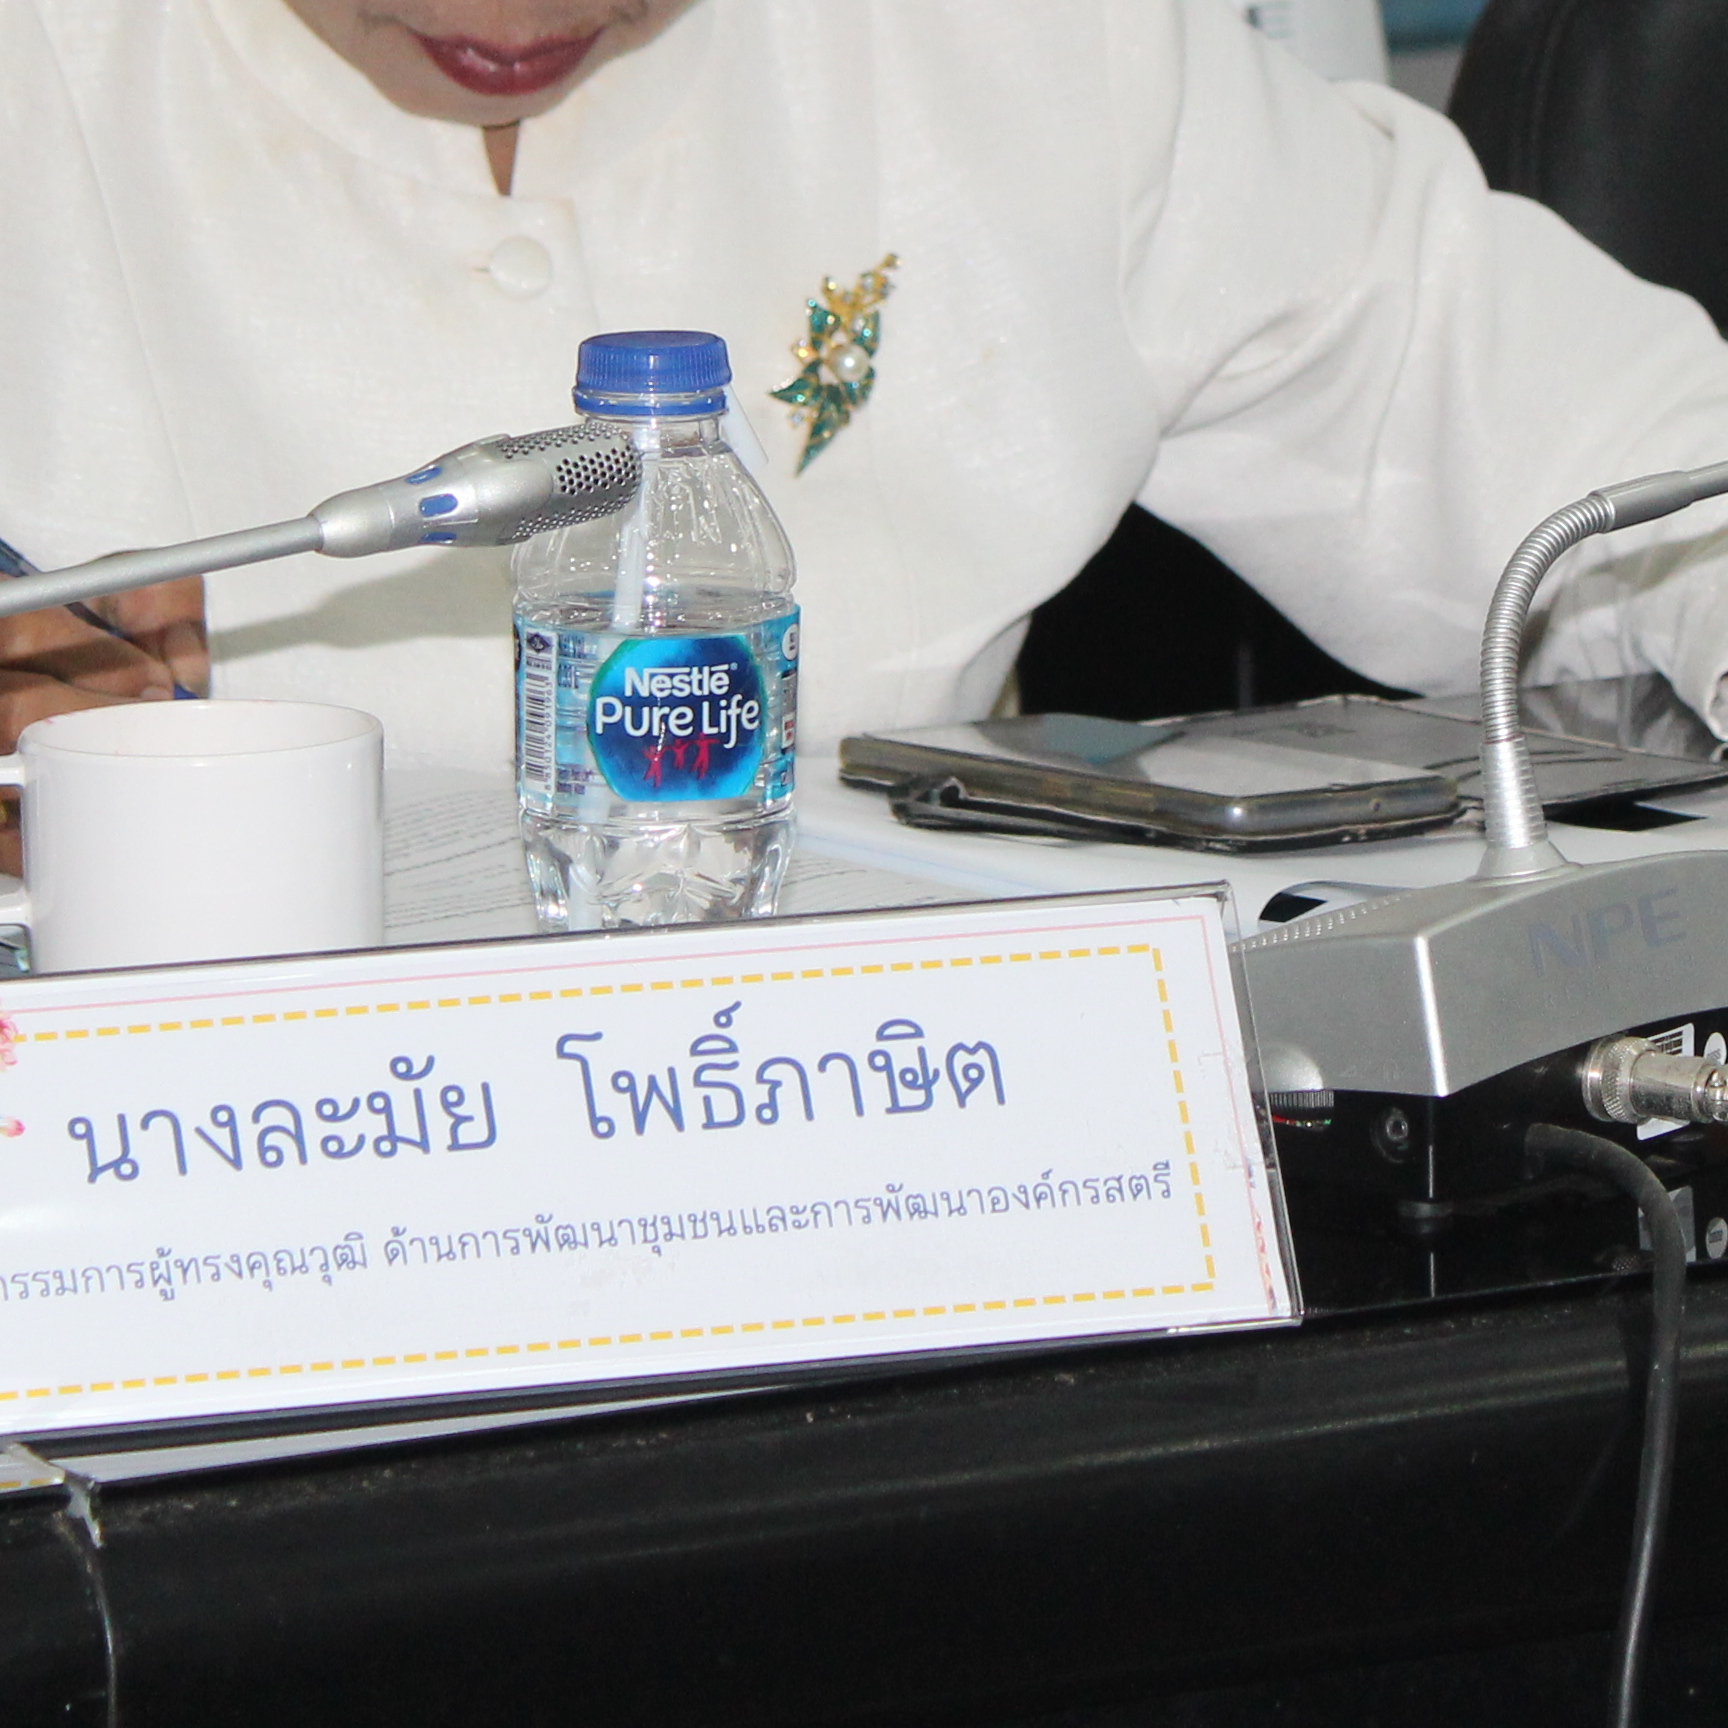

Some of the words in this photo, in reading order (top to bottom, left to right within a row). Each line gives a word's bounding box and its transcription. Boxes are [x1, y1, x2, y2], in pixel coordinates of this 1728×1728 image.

[595, 696, 694, 737] Pure
[702, 694, 760, 749] Life
[625, 664, 730, 698] Nestlé
[1528, 887, 1688, 979] NPE
[69, 1055, 499, 1184] นางละมัย
[555, 1000, 1007, 1141] โพธิ์ภาษิต
[383, 1160, 1175, 1269] ด้านการพัฒนาชุมชนและการพัฒนาองค์กรสตรี
